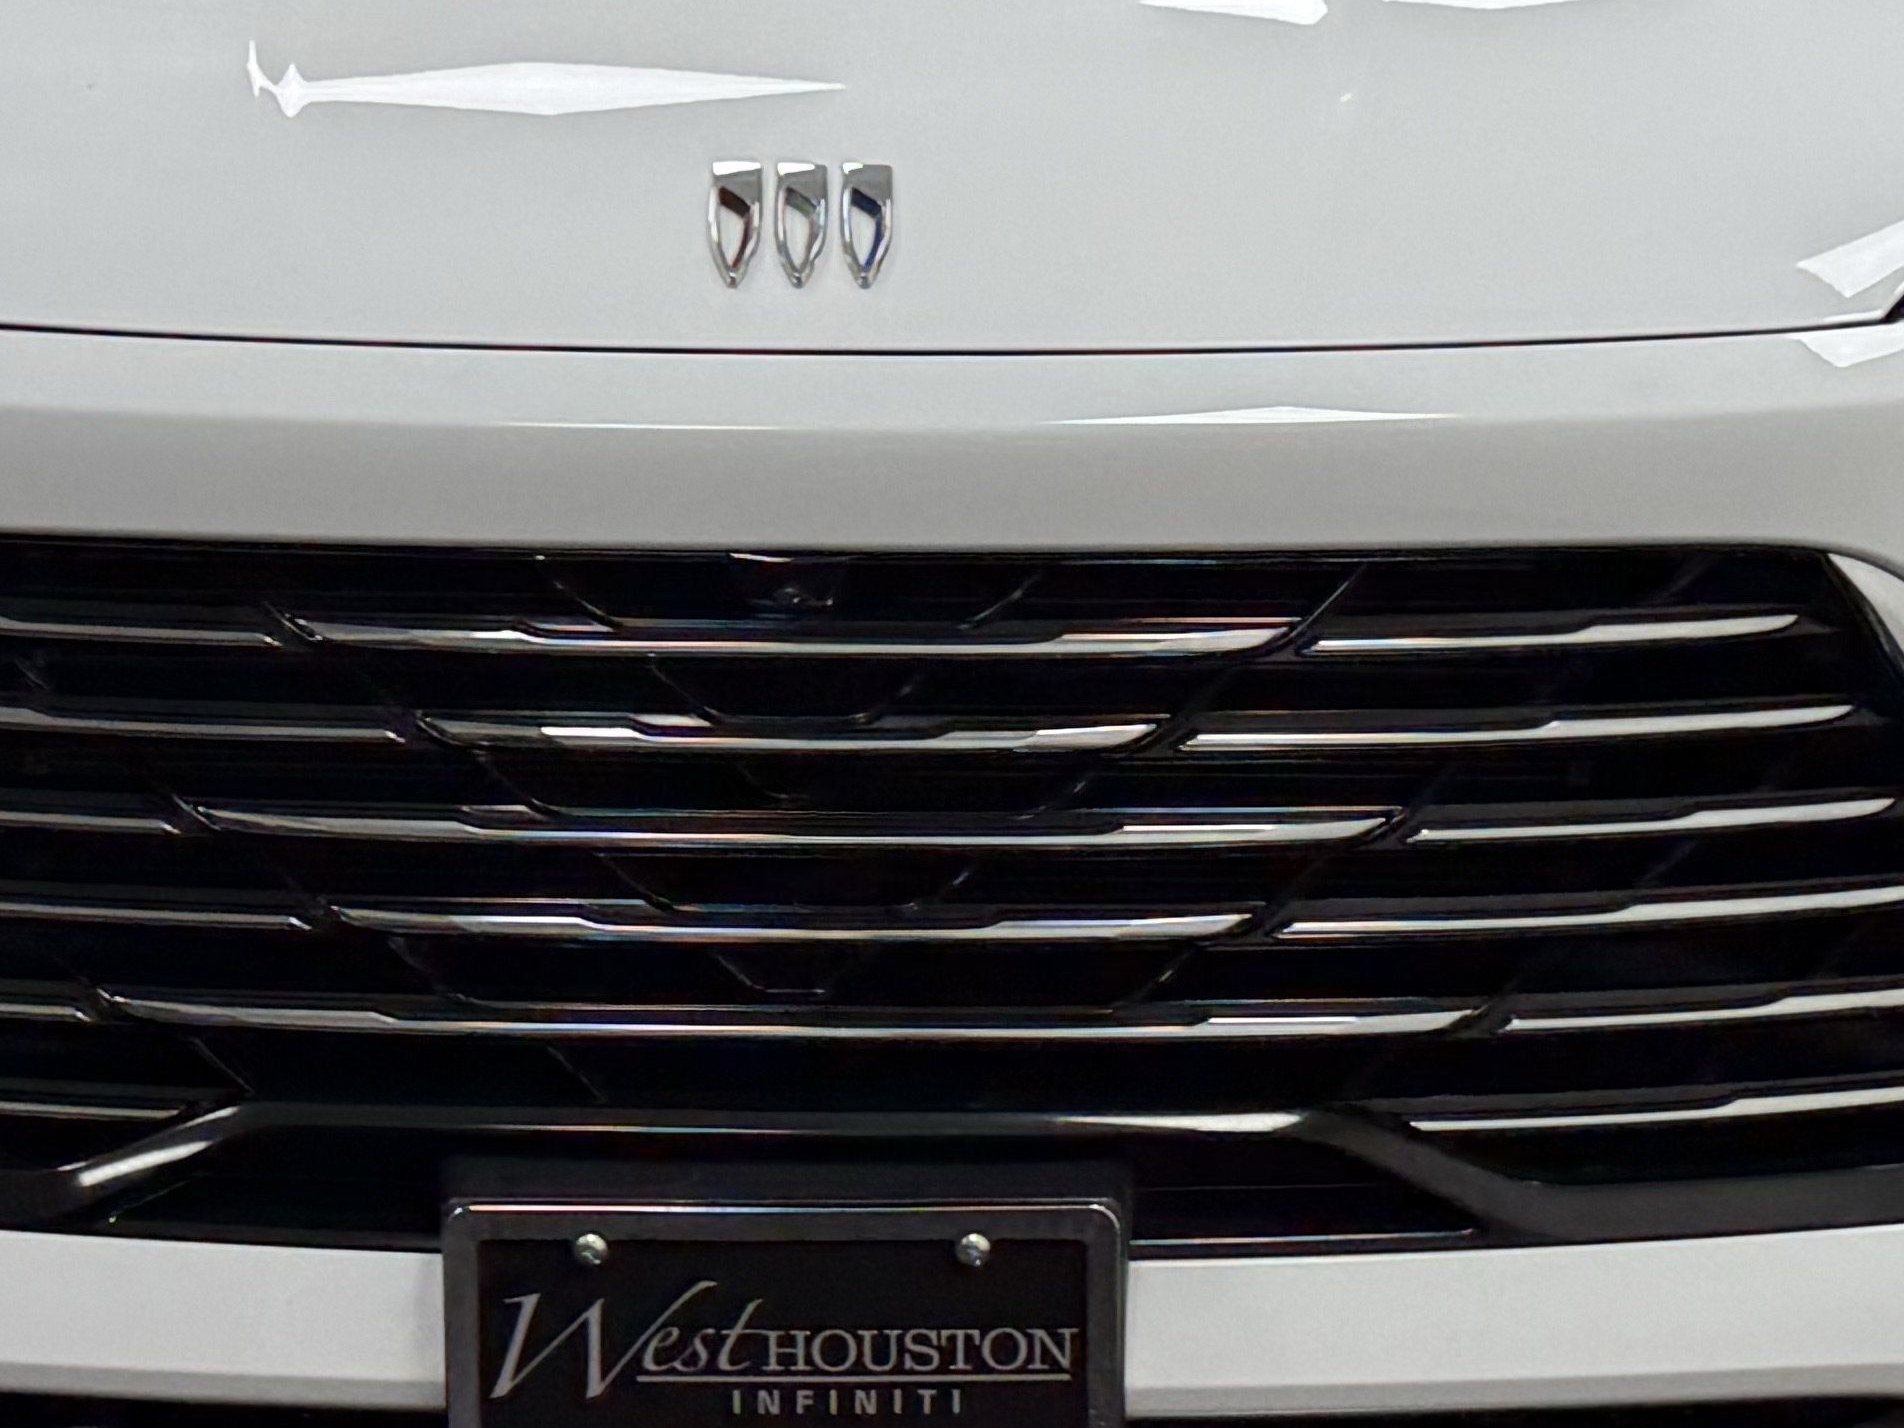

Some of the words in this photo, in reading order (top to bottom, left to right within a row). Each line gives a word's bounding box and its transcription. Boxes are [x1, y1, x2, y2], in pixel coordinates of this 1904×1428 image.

[489, 1280, 765, 1400] West
[765, 1328, 1079, 1371] HOUSTON
[732, 1388, 963, 1415] INFINITI
